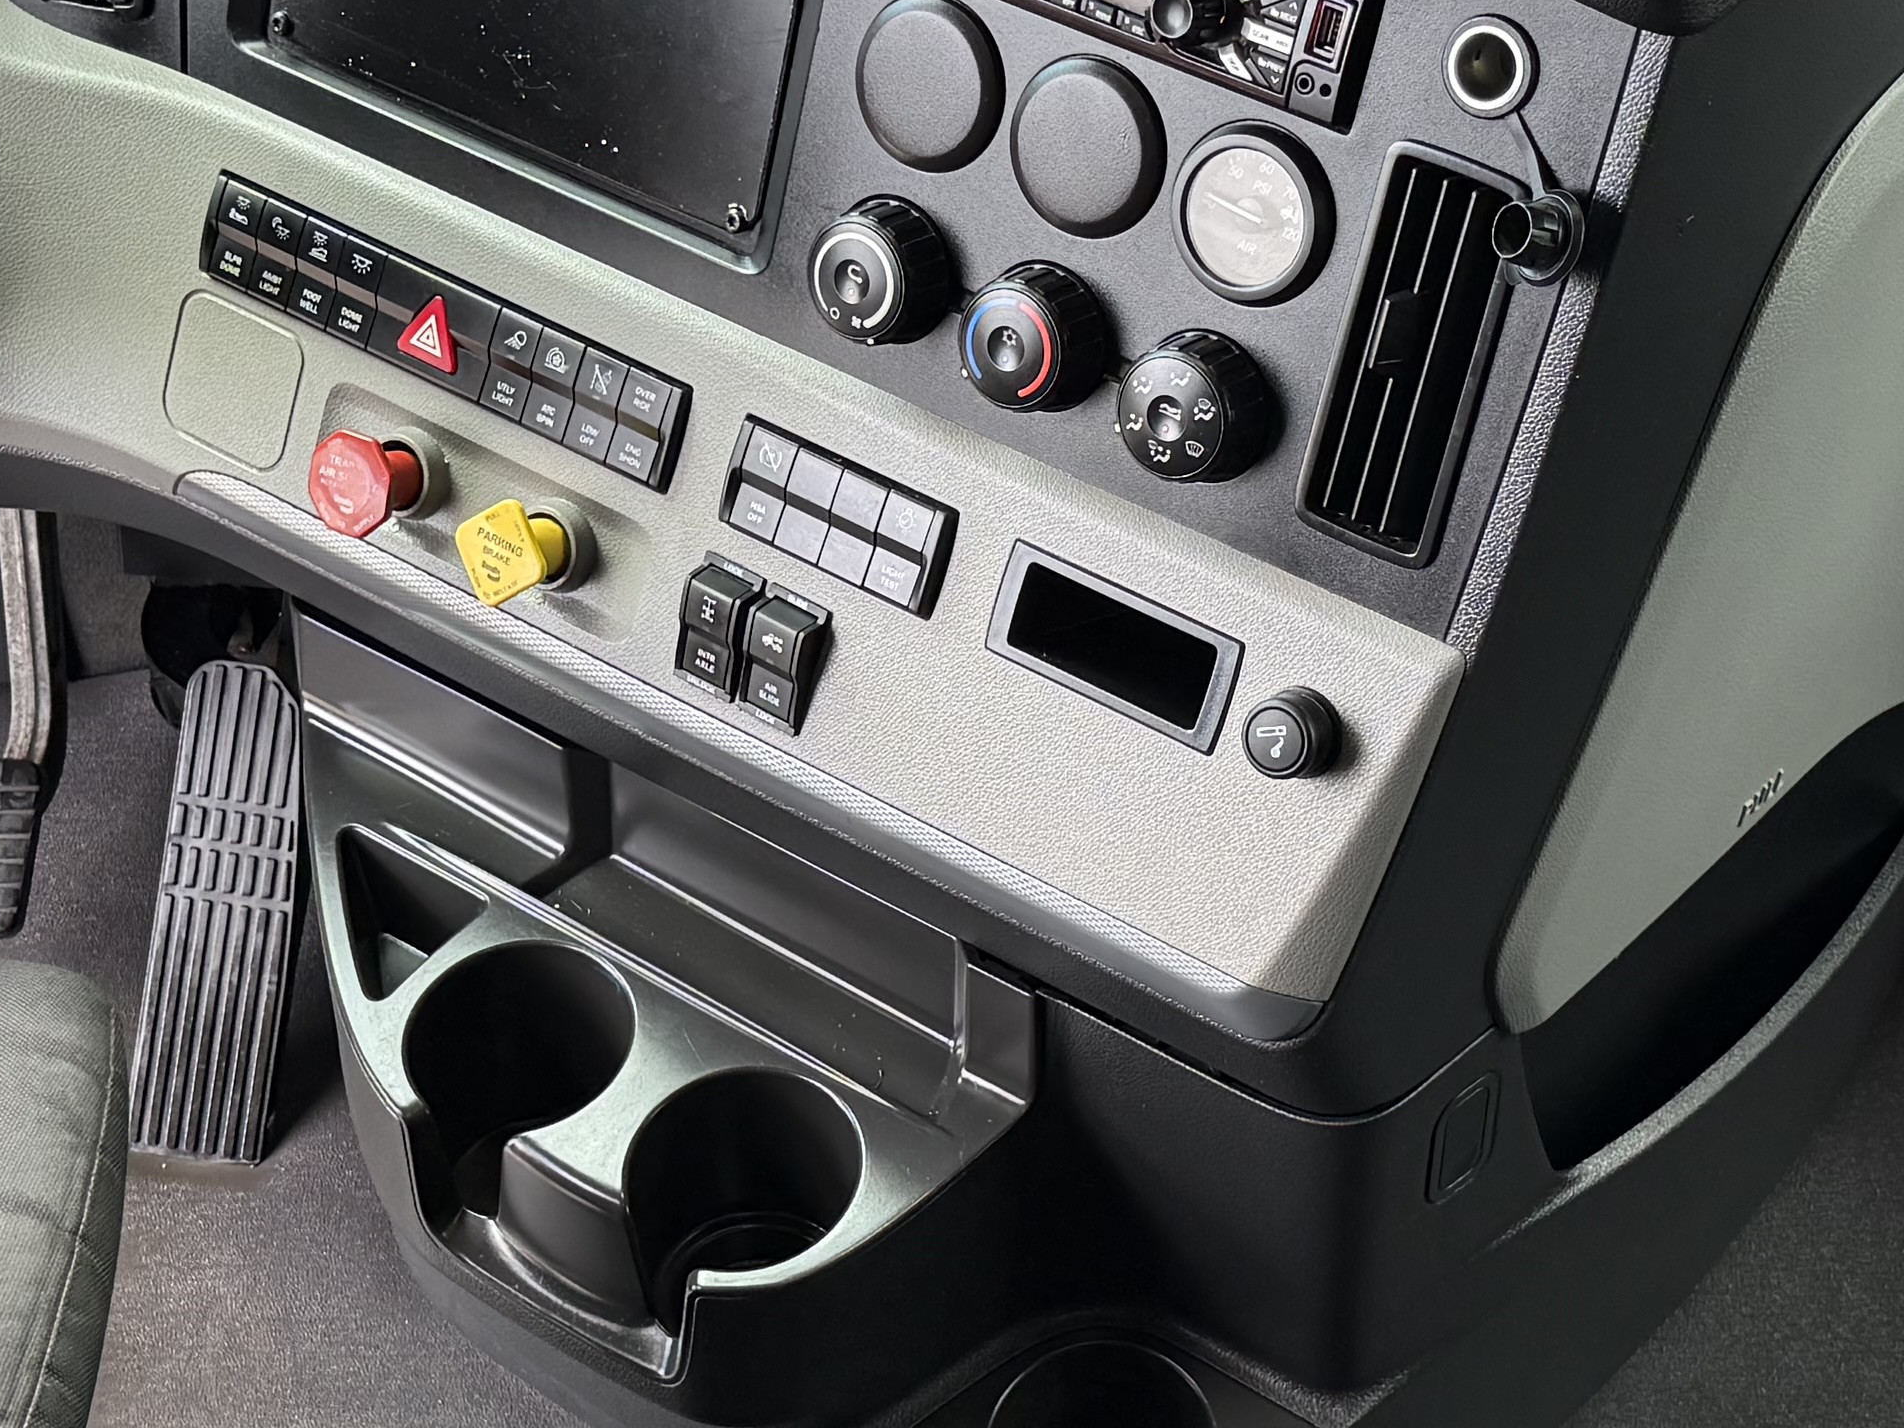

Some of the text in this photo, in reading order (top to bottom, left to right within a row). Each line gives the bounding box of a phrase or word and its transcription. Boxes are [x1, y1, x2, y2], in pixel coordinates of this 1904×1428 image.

[1259, 162, 1274, 175] 60
[1251, 180, 1272, 196] PSI
[1236, 240, 1257, 255] AIR
[302, 288, 322, 303] FOOT
[299, 300, 318, 315] WELL
[492, 392, 513, 407] LIGHT
[635, 386, 656, 402] OVER
[580, 434, 594, 446] OFF
[625, 443, 641, 456] ENG
[747, 511, 762, 524] OFF
[477, 527, 523, 557] PARKING
[482, 545, 511, 566] BRAKE
[881, 564, 906, 582] LIGHT
[880, 576, 900, 591] TEST
